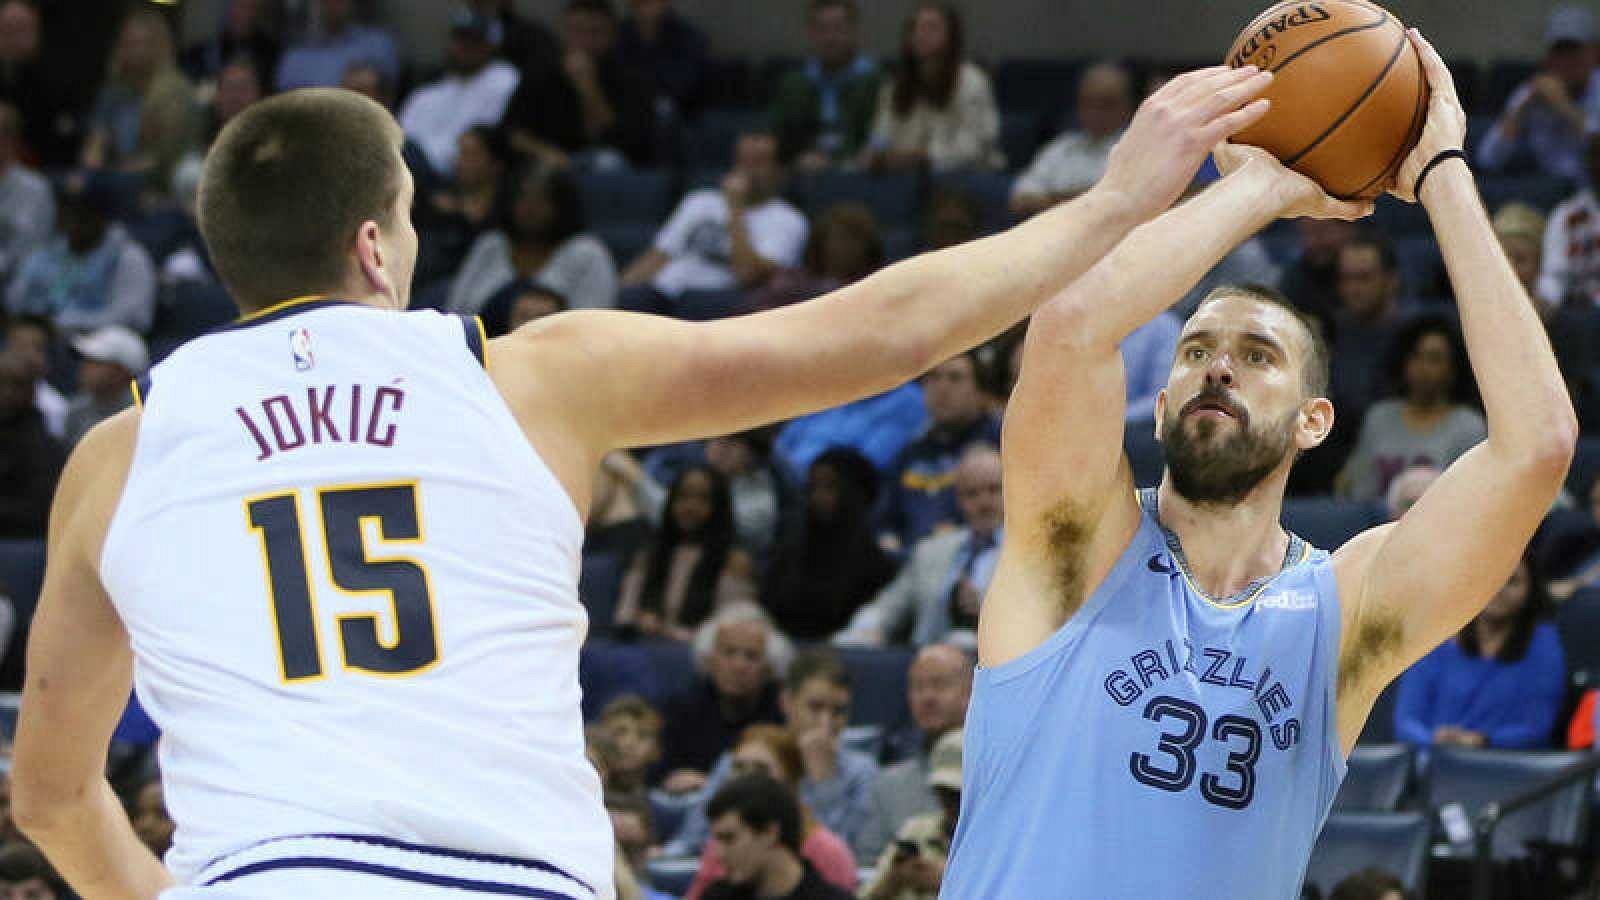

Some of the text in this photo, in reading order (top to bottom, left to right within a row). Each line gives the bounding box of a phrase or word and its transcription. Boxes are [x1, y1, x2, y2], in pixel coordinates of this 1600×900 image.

[235, 377, 405, 461] JOKIĆ
[243, 480, 442, 684] 15
[1129, 695, 1263, 810] 33
